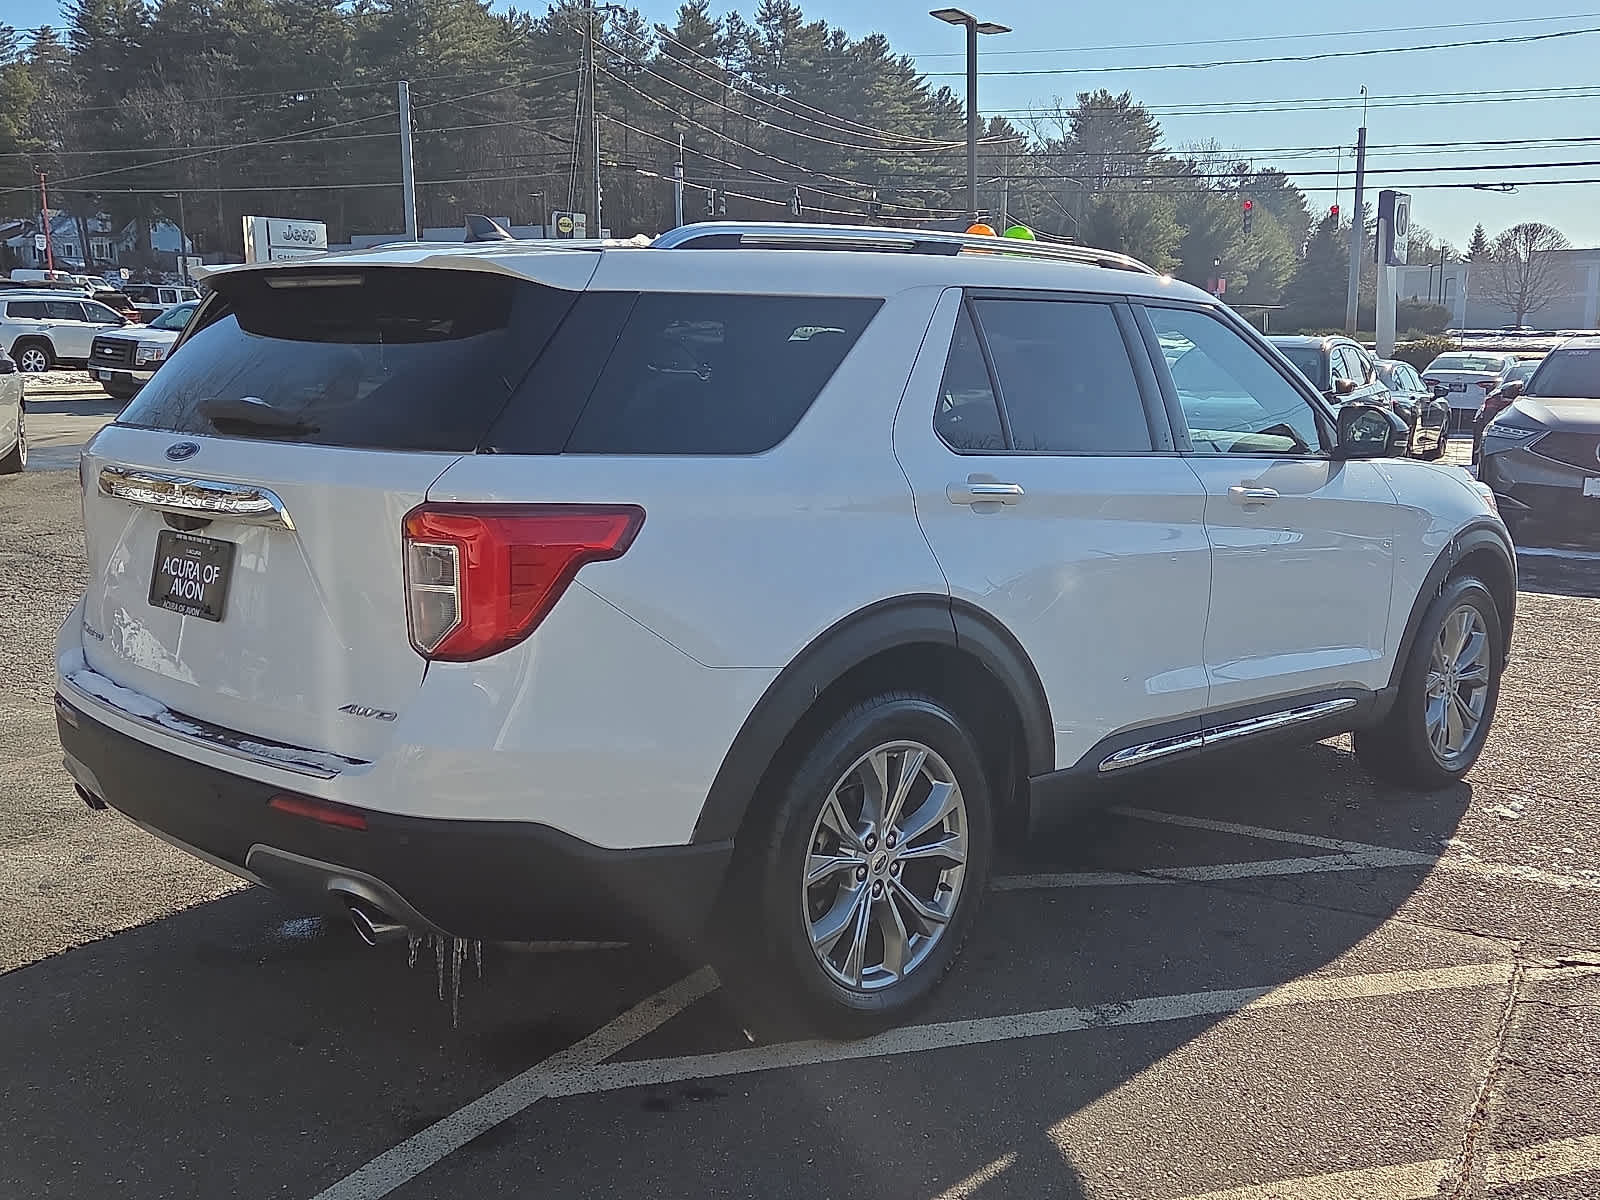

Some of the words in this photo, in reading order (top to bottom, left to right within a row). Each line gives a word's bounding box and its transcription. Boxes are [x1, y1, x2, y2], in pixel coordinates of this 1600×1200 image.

[282, 224, 317, 245] Jeep
[161, 556, 200, 581] ACURA
[202, 564, 220, 584] OF
[169, 577, 205, 602] AVON
[162, 600, 178, 611] ACURA
[185, 606, 201, 617] AVON
